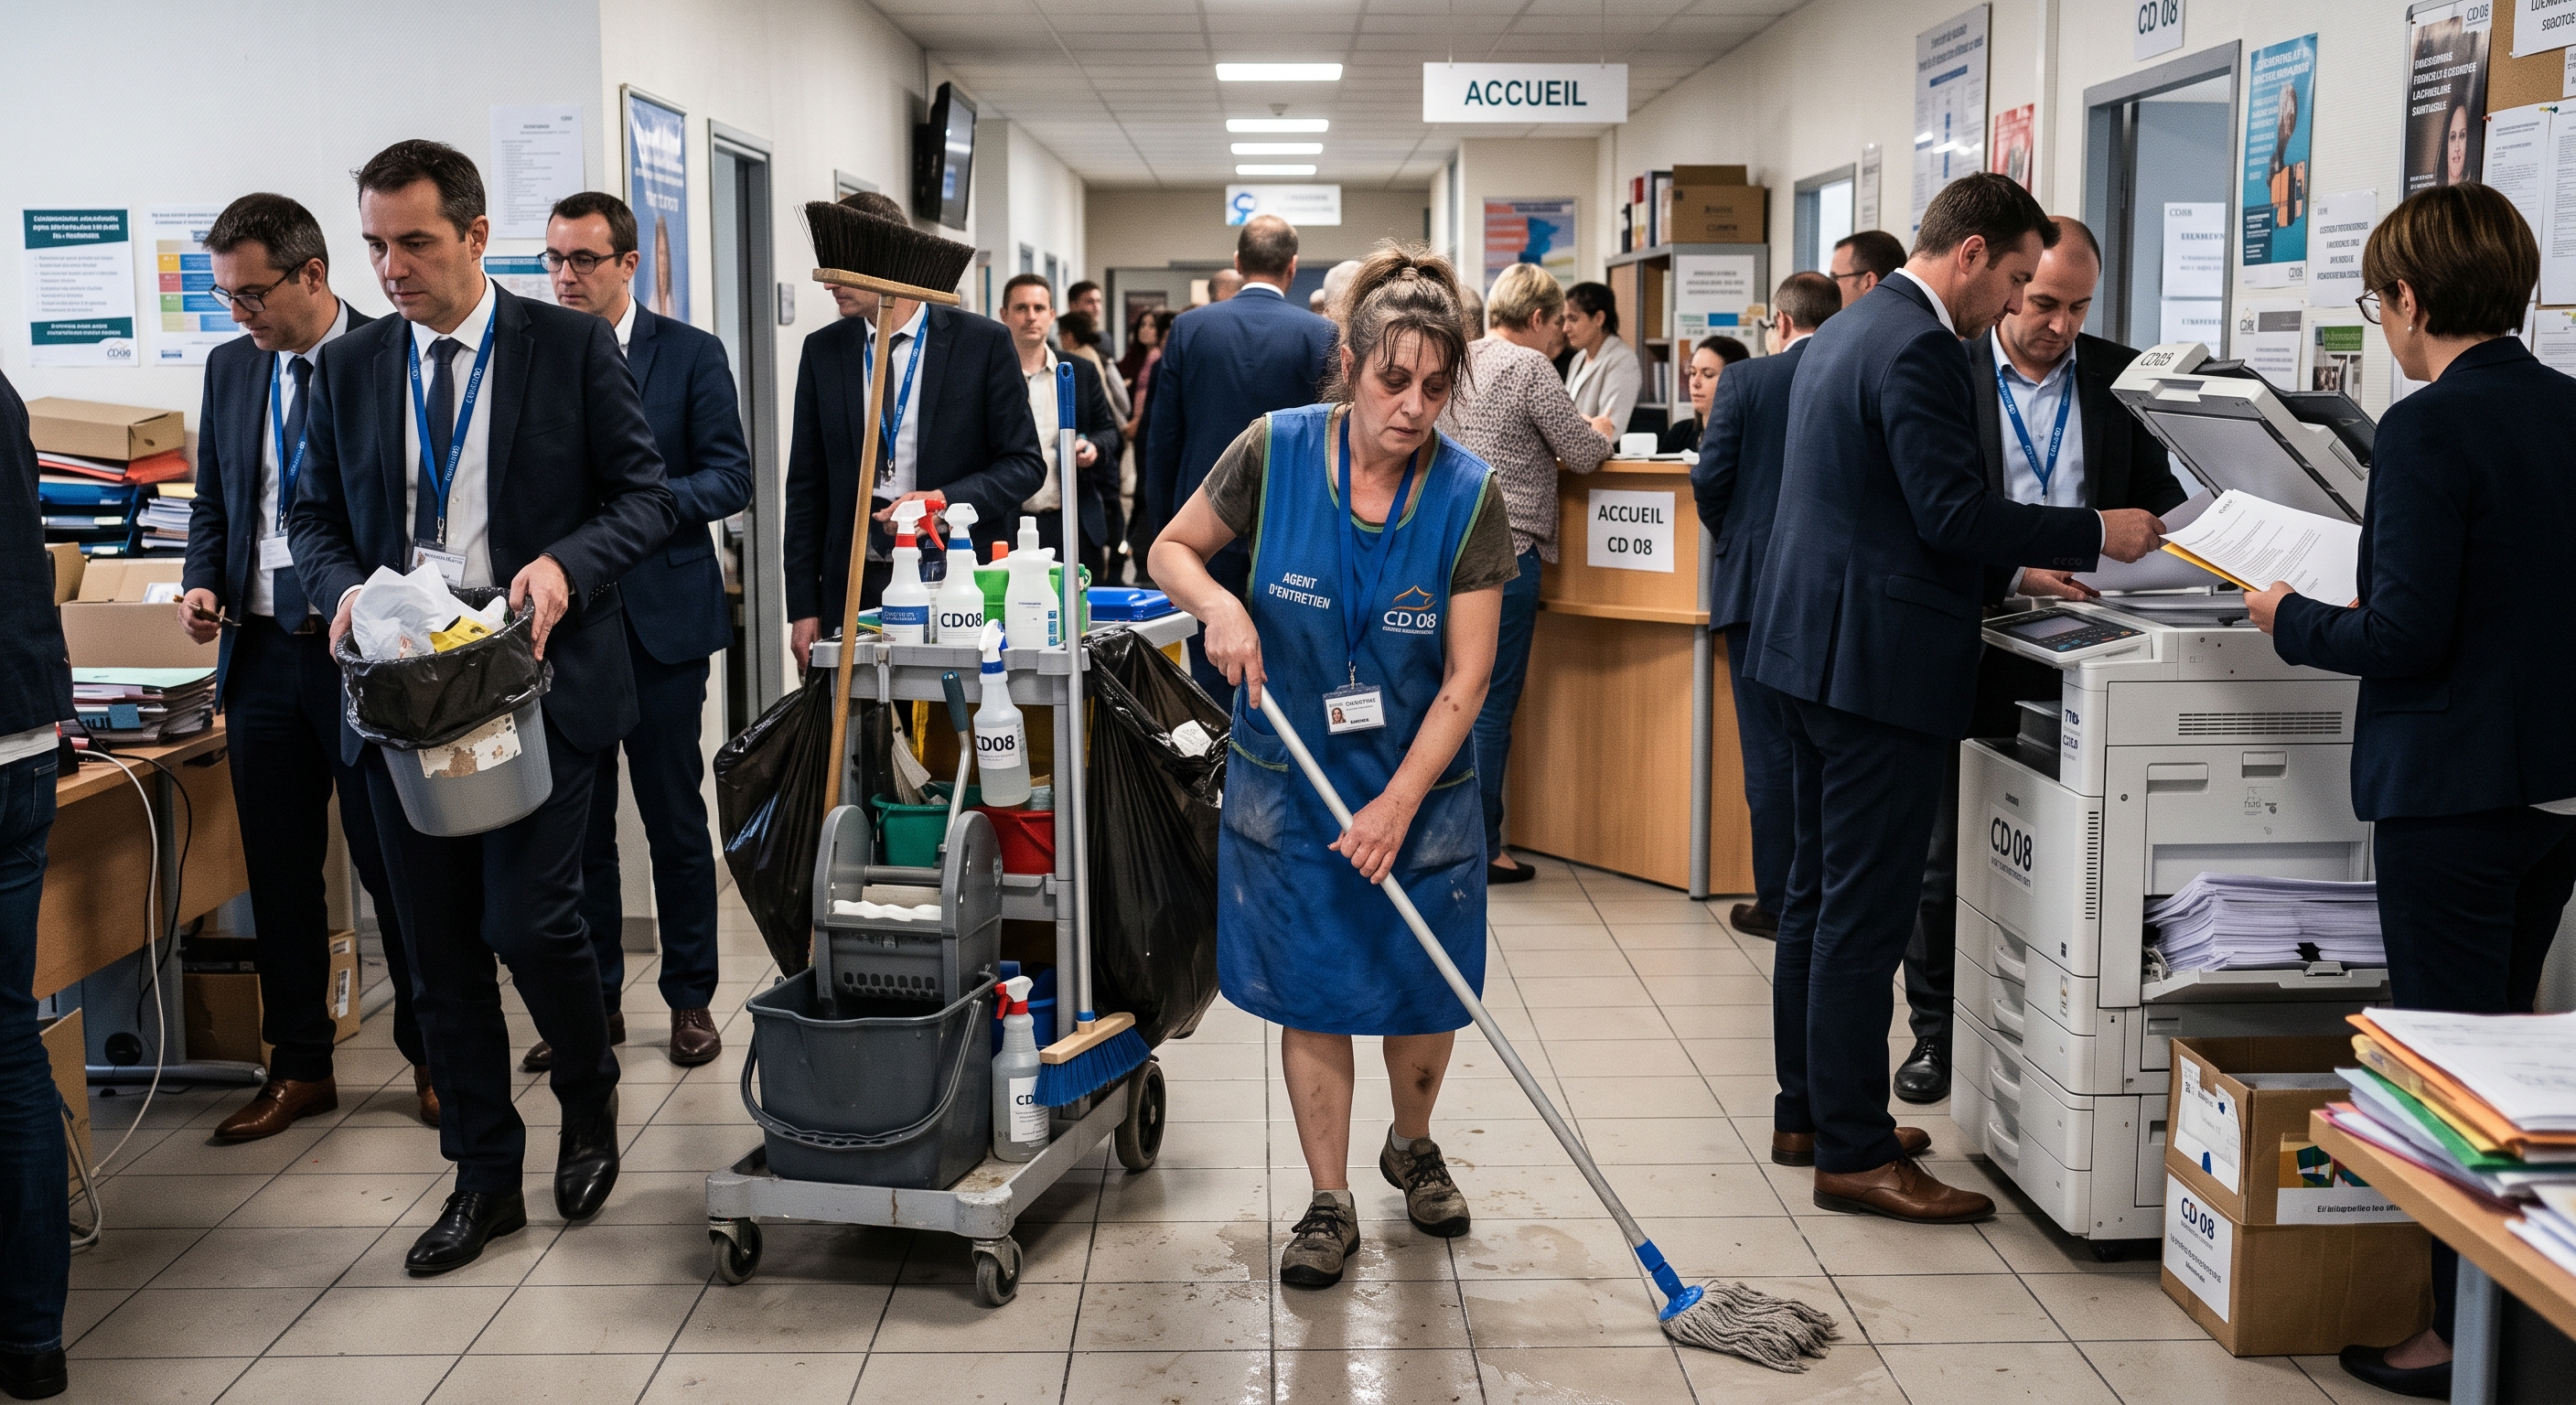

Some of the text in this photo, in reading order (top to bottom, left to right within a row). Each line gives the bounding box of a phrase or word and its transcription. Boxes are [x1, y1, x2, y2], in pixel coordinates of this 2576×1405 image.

[2138, 0, 2178, 35] CD 08
[1465, 80, 1587, 106] ACCUEIL
[1597, 505, 1664, 524] ACCUEIL
[1607, 537, 1652, 555] CD 08
[1283, 572, 1317, 589] AGENT
[1269, 584, 1331, 610] D'ENTRETIEN
[940, 613, 982, 628] CD08
[1383, 611, 1437, 628] CD 08
[1016, 1094, 1034, 1106] CD
[2181, 1197, 2215, 1240] CD 08
